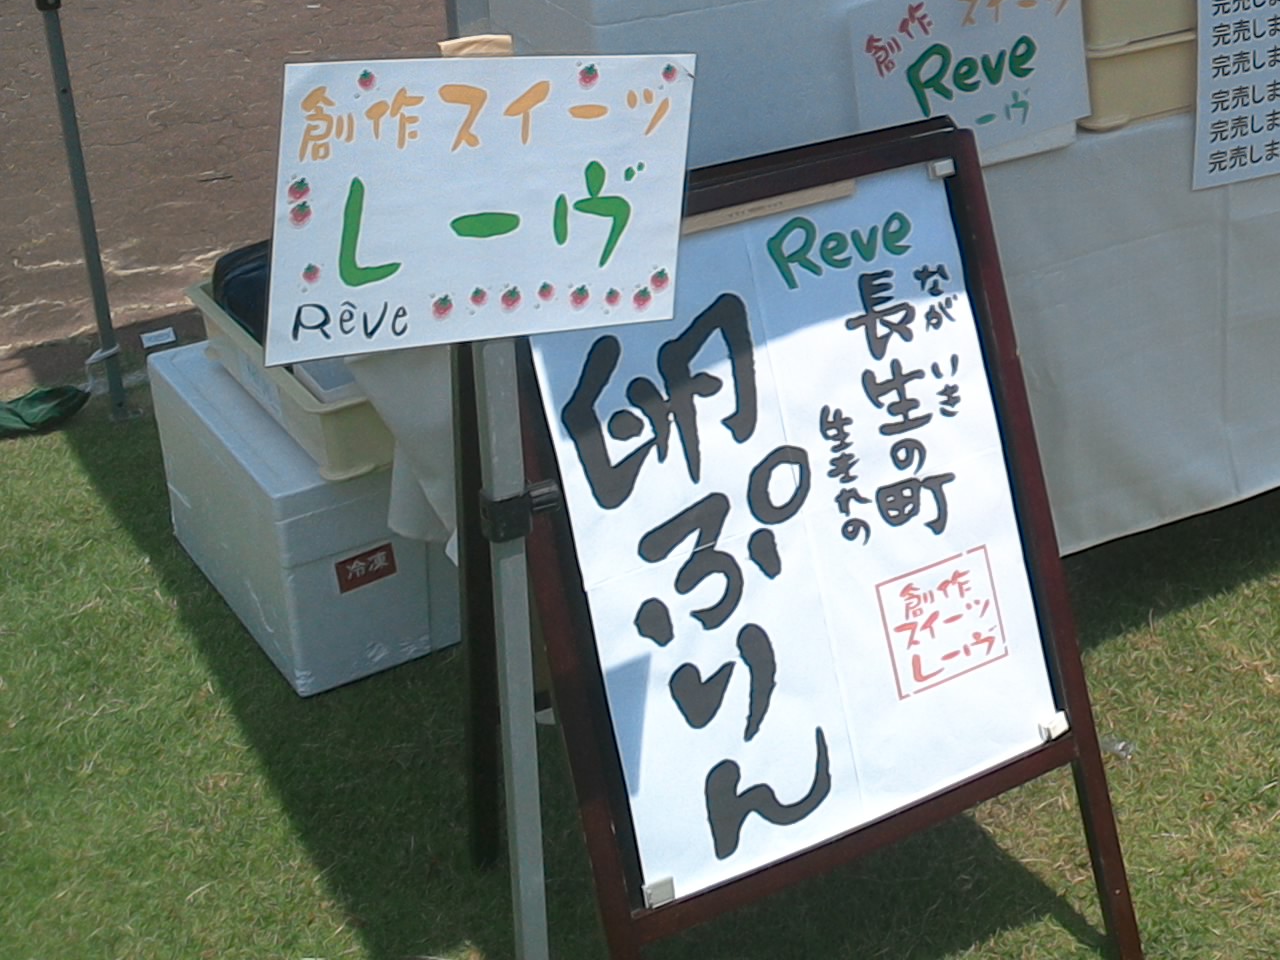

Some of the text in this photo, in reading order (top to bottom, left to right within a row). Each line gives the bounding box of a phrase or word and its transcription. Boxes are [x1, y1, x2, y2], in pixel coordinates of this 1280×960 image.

[905, 34, 1038, 118] Reve
[299, 79, 671, 163] 創作スイーツ
[766, 209, 912, 290] Reve
[291, 300, 410, 342] Rêve
[845, 269, 956, 536] 長生の町
[893, 598, 990, 651] スイーツ
[899, 569, 972, 621] 創作
